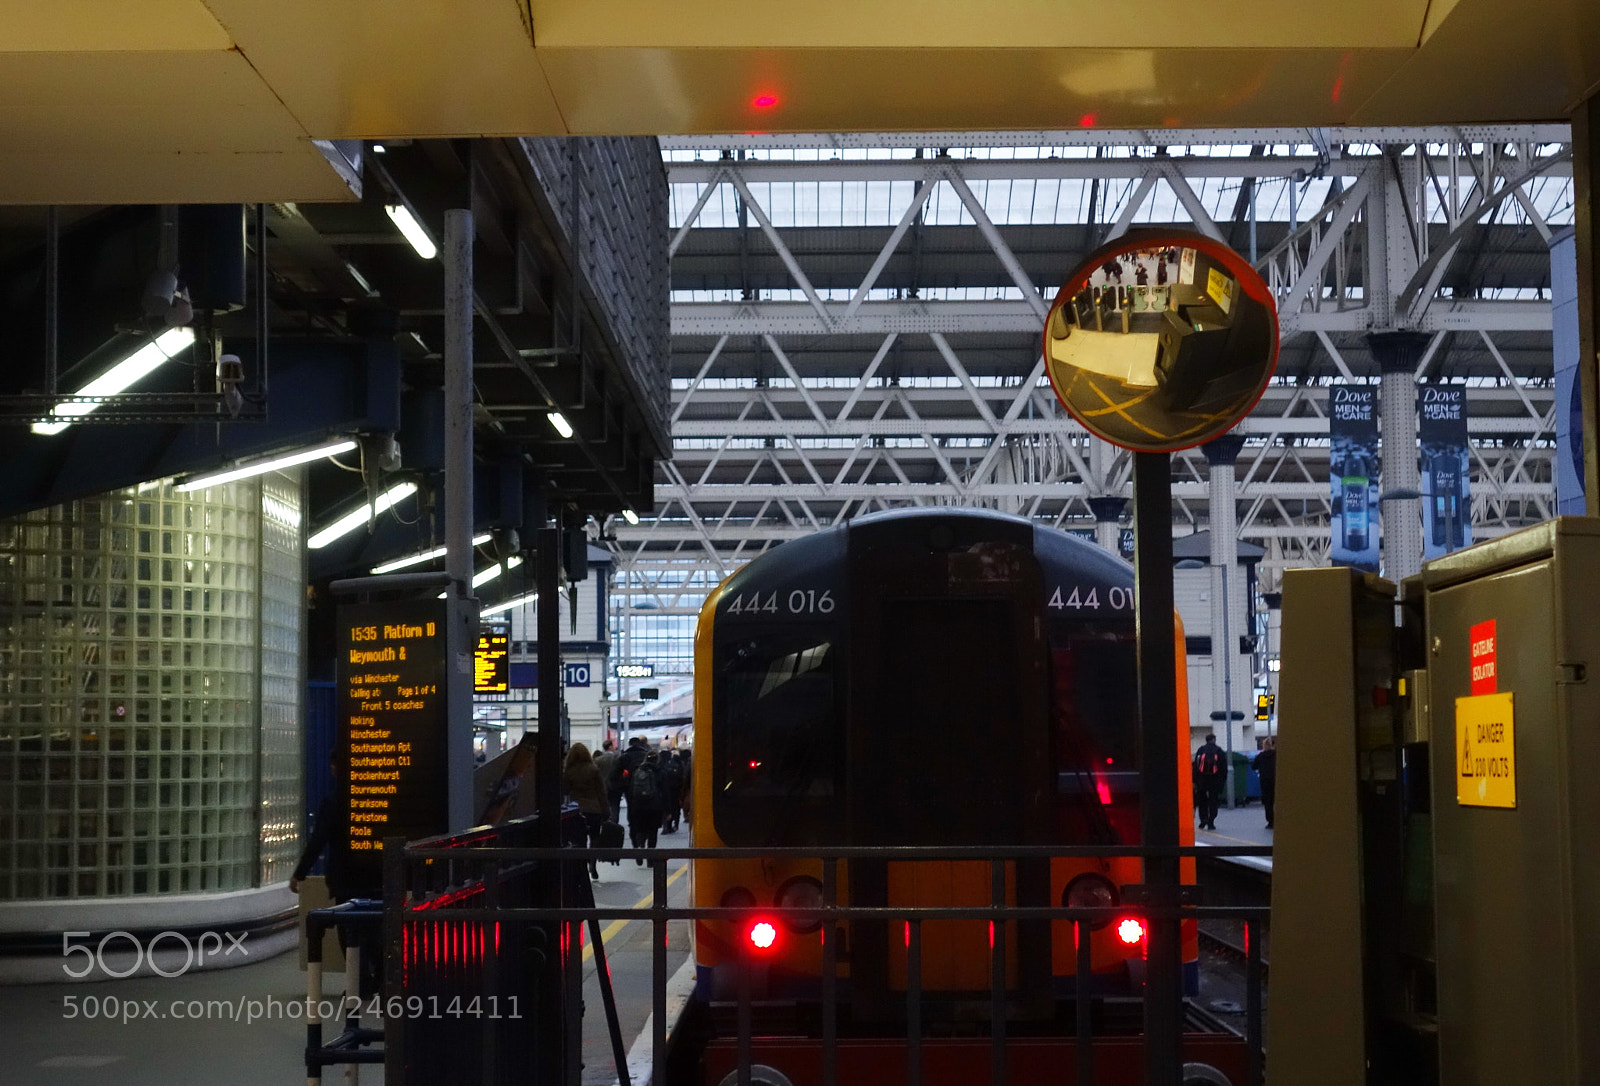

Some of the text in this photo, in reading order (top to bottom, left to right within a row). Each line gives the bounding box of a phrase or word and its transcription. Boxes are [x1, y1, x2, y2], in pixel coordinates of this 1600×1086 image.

[1335, 387, 1372, 402] Dove
[1424, 387, 1460, 402] Dove
[1335, 404, 1360, 413] MEN
[1424, 404, 1449, 413] MEN
[1335, 412, 1371, 420] +CARE
[1424, 412, 1460, 420] +CARE
[727, 590, 835, 615] 444 016
[1047, 585, 1136, 610] 444 01
[384, 624, 423, 639] Platform
[426, 622, 436, 637] 10
[1473, 637, 1494, 658] GATELINE
[350, 646, 407, 664] Weymouth &
[568, 668, 589, 683] 10
[1472, 662, 1495, 681] ISOLATOR
[350, 673, 400, 684] via Winchester
[350, 688, 371, 699] Calling
[398, 686, 414, 698] Page
[421, 685, 429, 695] of
[431, 685, 437, 694] 4
[361, 700, 425, 711] Front 5 coaches
[350, 716, 375, 727] Woking
[350, 730, 392, 739] Winchester
[1477, 723, 1505, 744] DANGER
[350, 742, 412, 754] Southampton Apt
[350, 757, 396, 768] Southampton
[1487, 757, 1509, 778] VOLTS
[350, 770, 400, 781] Brockenhurst
[350, 785, 397, 795] Bournemouth
[350, 799, 389, 808] Branksome
[350, 812, 388, 822] Parkstone
[350, 826, 372, 836] Poole
[350, 840, 372, 850] South
